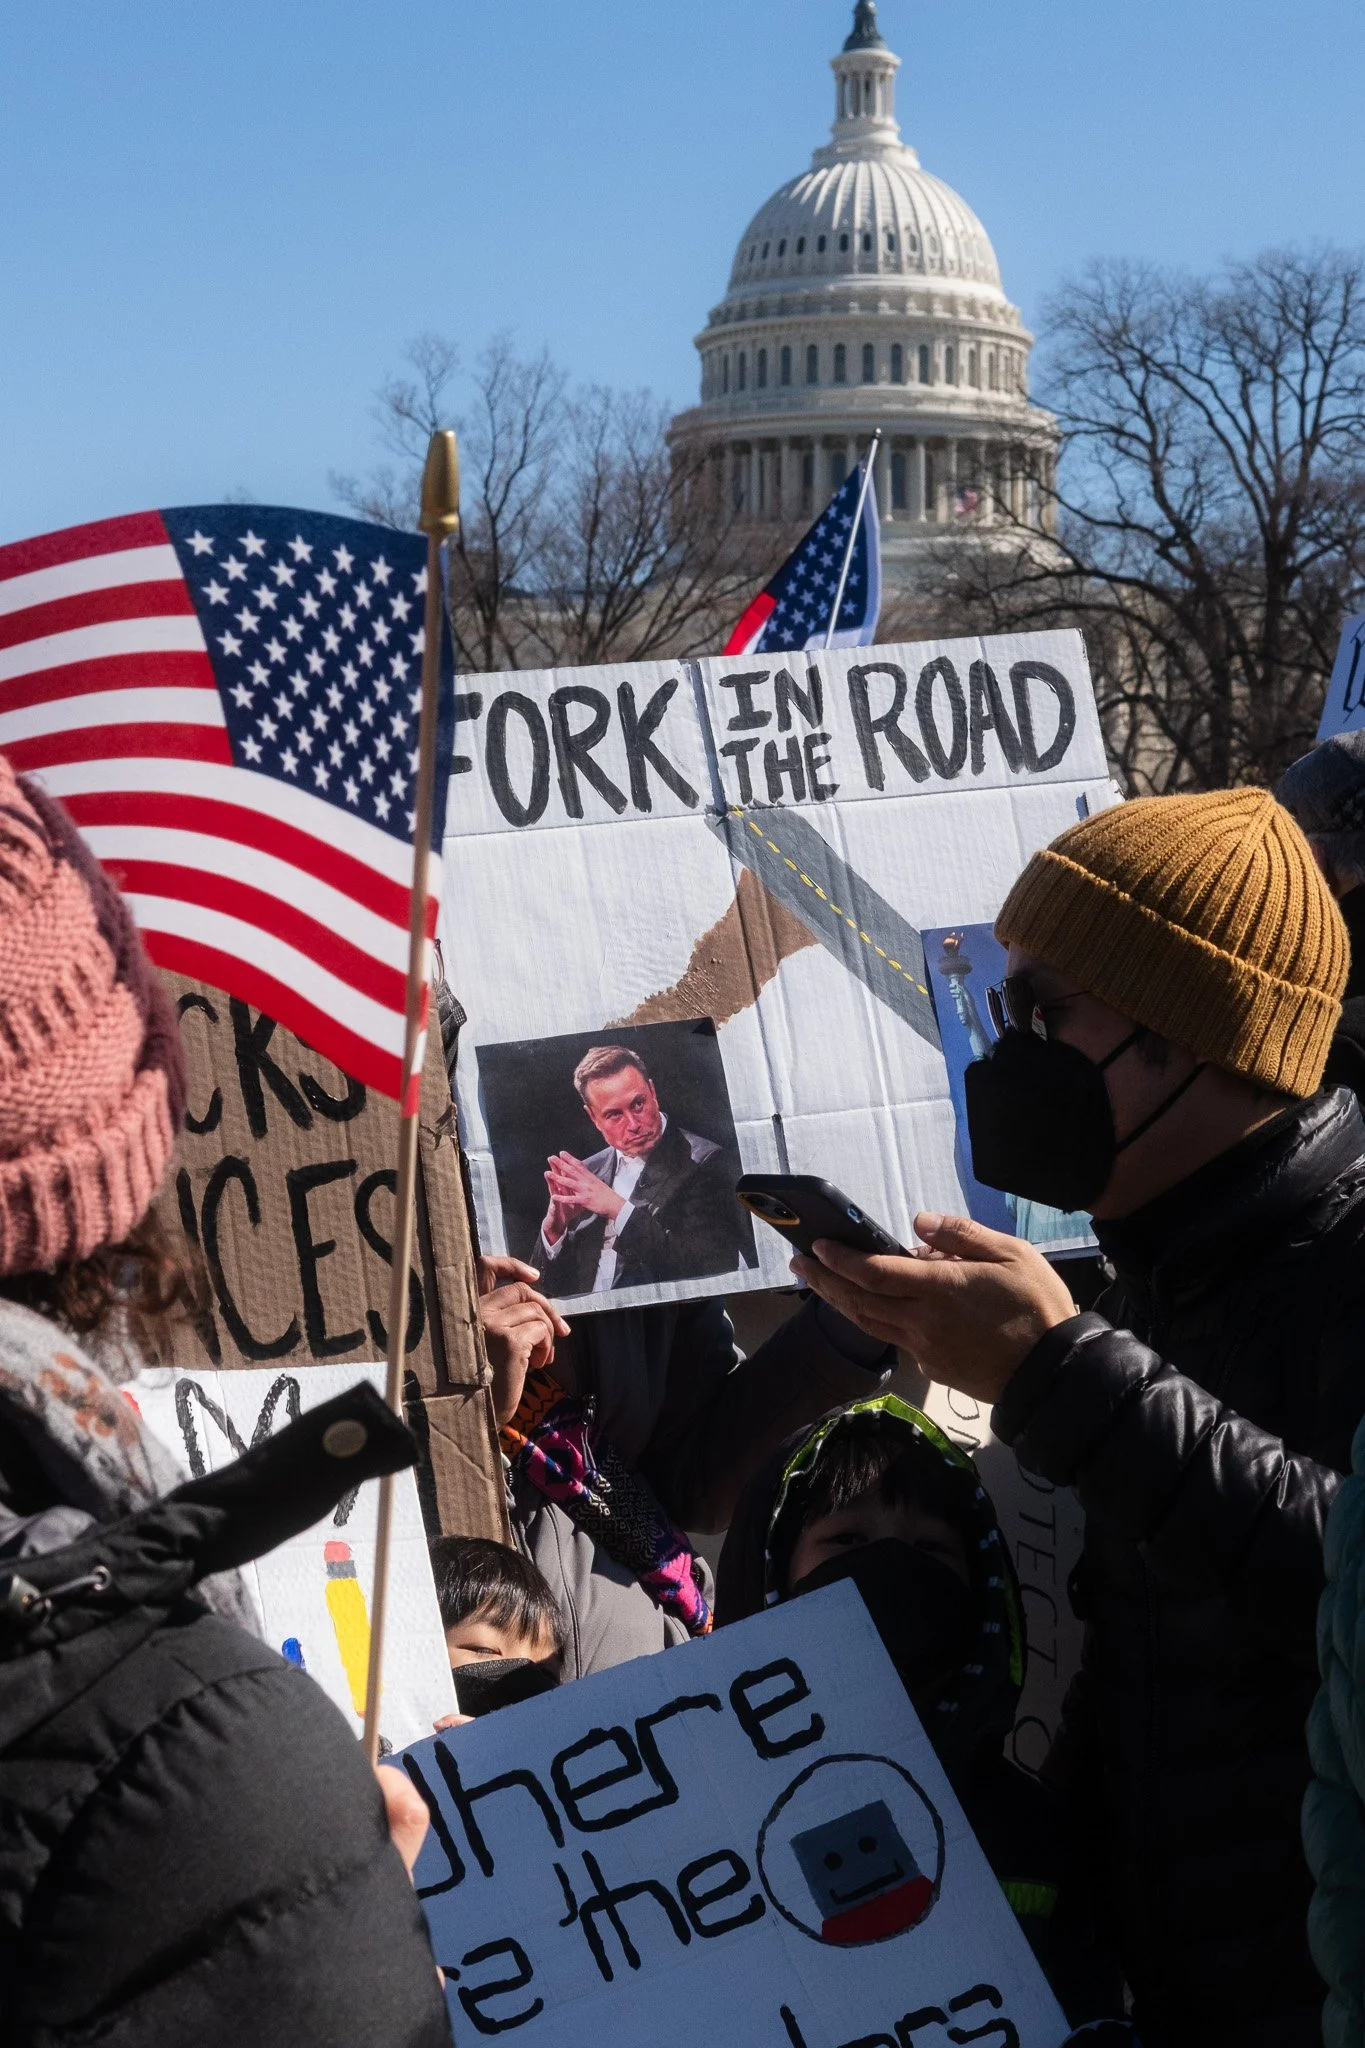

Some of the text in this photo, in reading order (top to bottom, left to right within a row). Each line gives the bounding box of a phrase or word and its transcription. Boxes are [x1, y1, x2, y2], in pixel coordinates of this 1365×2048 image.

[718, 664, 824, 733] IN
[846, 656, 1076, 791] ROAD
[718, 731, 841, 802] THE
